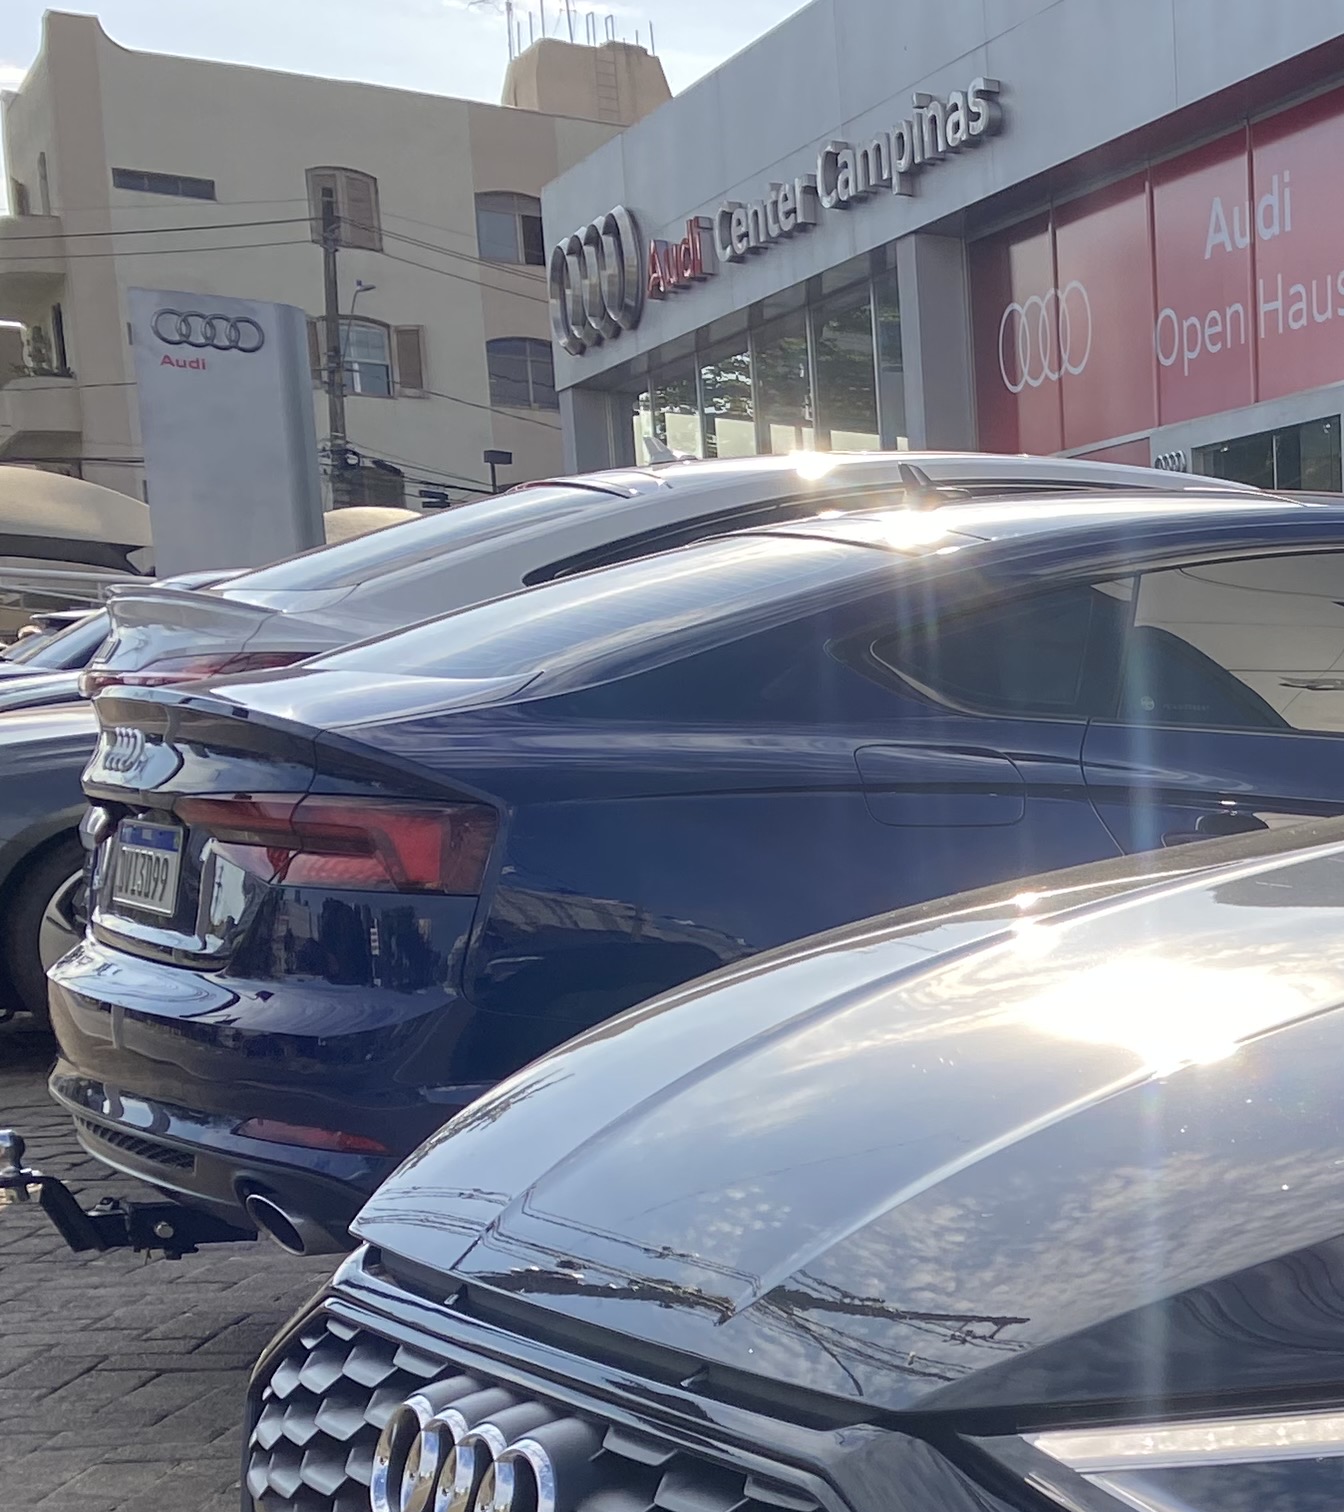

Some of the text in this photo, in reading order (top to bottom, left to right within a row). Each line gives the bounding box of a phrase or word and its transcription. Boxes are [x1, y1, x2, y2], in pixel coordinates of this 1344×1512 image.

[648, 77, 1000, 300] Audi Center Campinas
[1204, 169, 1292, 260] Audi
[160, 354, 207, 371] Audi
[1156, 303, 1246, 376] Open
